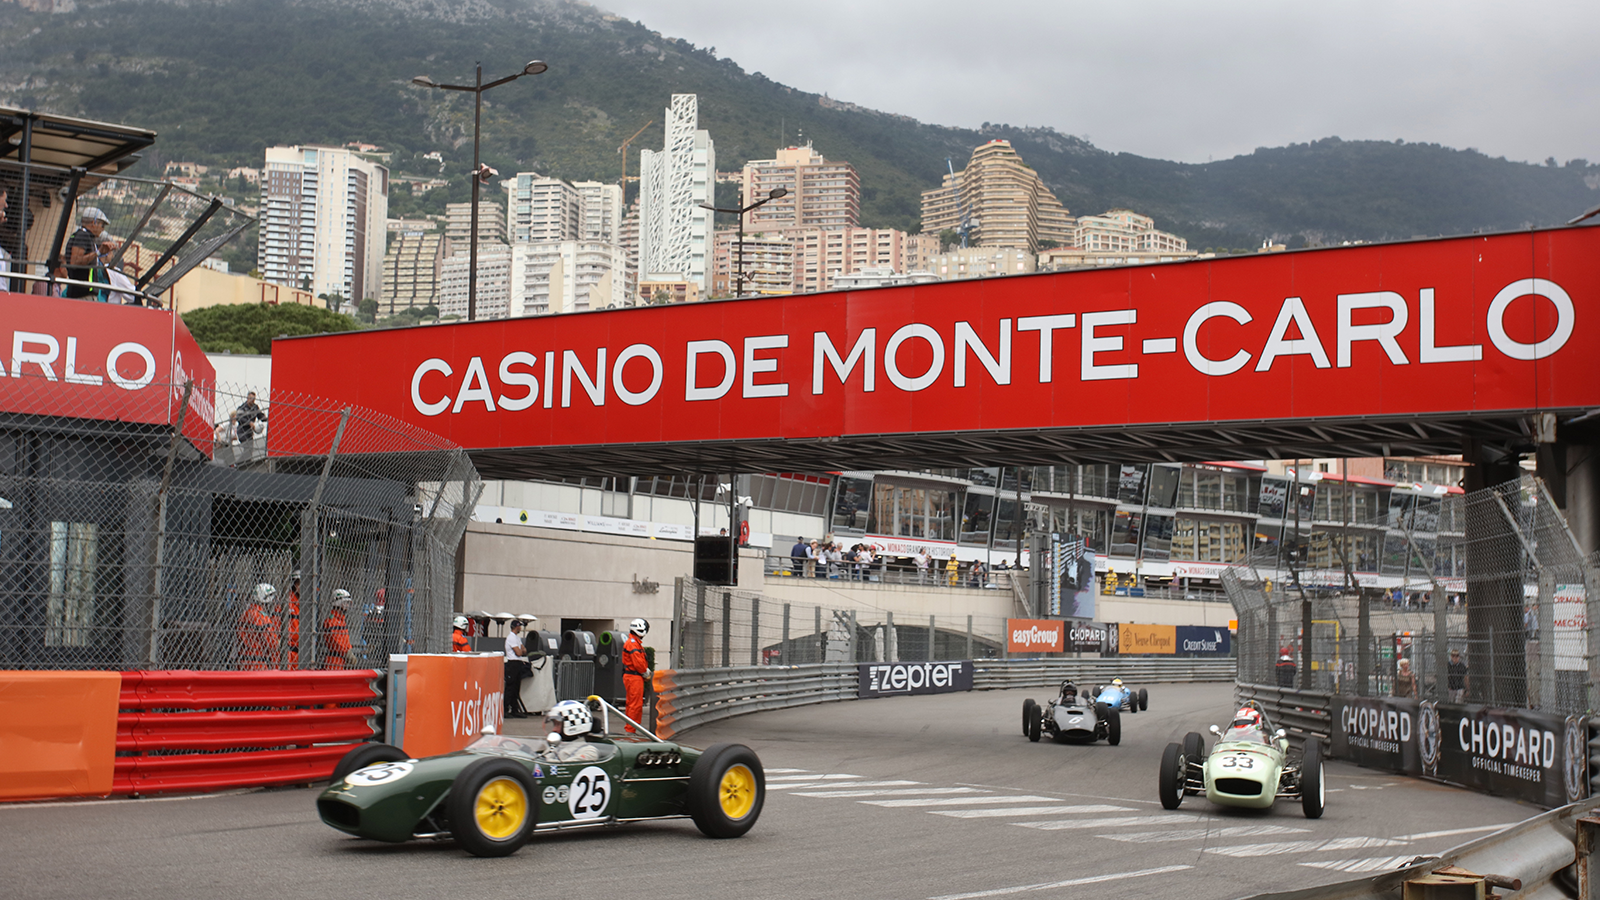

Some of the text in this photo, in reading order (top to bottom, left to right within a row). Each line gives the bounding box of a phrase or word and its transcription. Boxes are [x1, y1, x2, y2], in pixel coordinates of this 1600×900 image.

[411, 277, 1575, 417] CASINO DE MONTE-CARLO
[1012, 625, 1058, 647] easyGroup
[1069, 628, 1106, 641] CHOPARD
[1183, 639, 1217, 651] CREDIT SUISSE
[878, 662, 962, 692] zepter
[450, 680, 481, 737] visit
[1341, 704, 1411, 742] CHOPARD
[1348, 735, 1400, 754] OFFICIAL TIMEKEEPER
[1458, 716, 1555, 769] CHOPARD
[1222, 756, 1254, 769] 33
[1472, 756, 1541, 783] OFFICIAL TIMEKEEPER
[574, 774, 606, 814] 25
